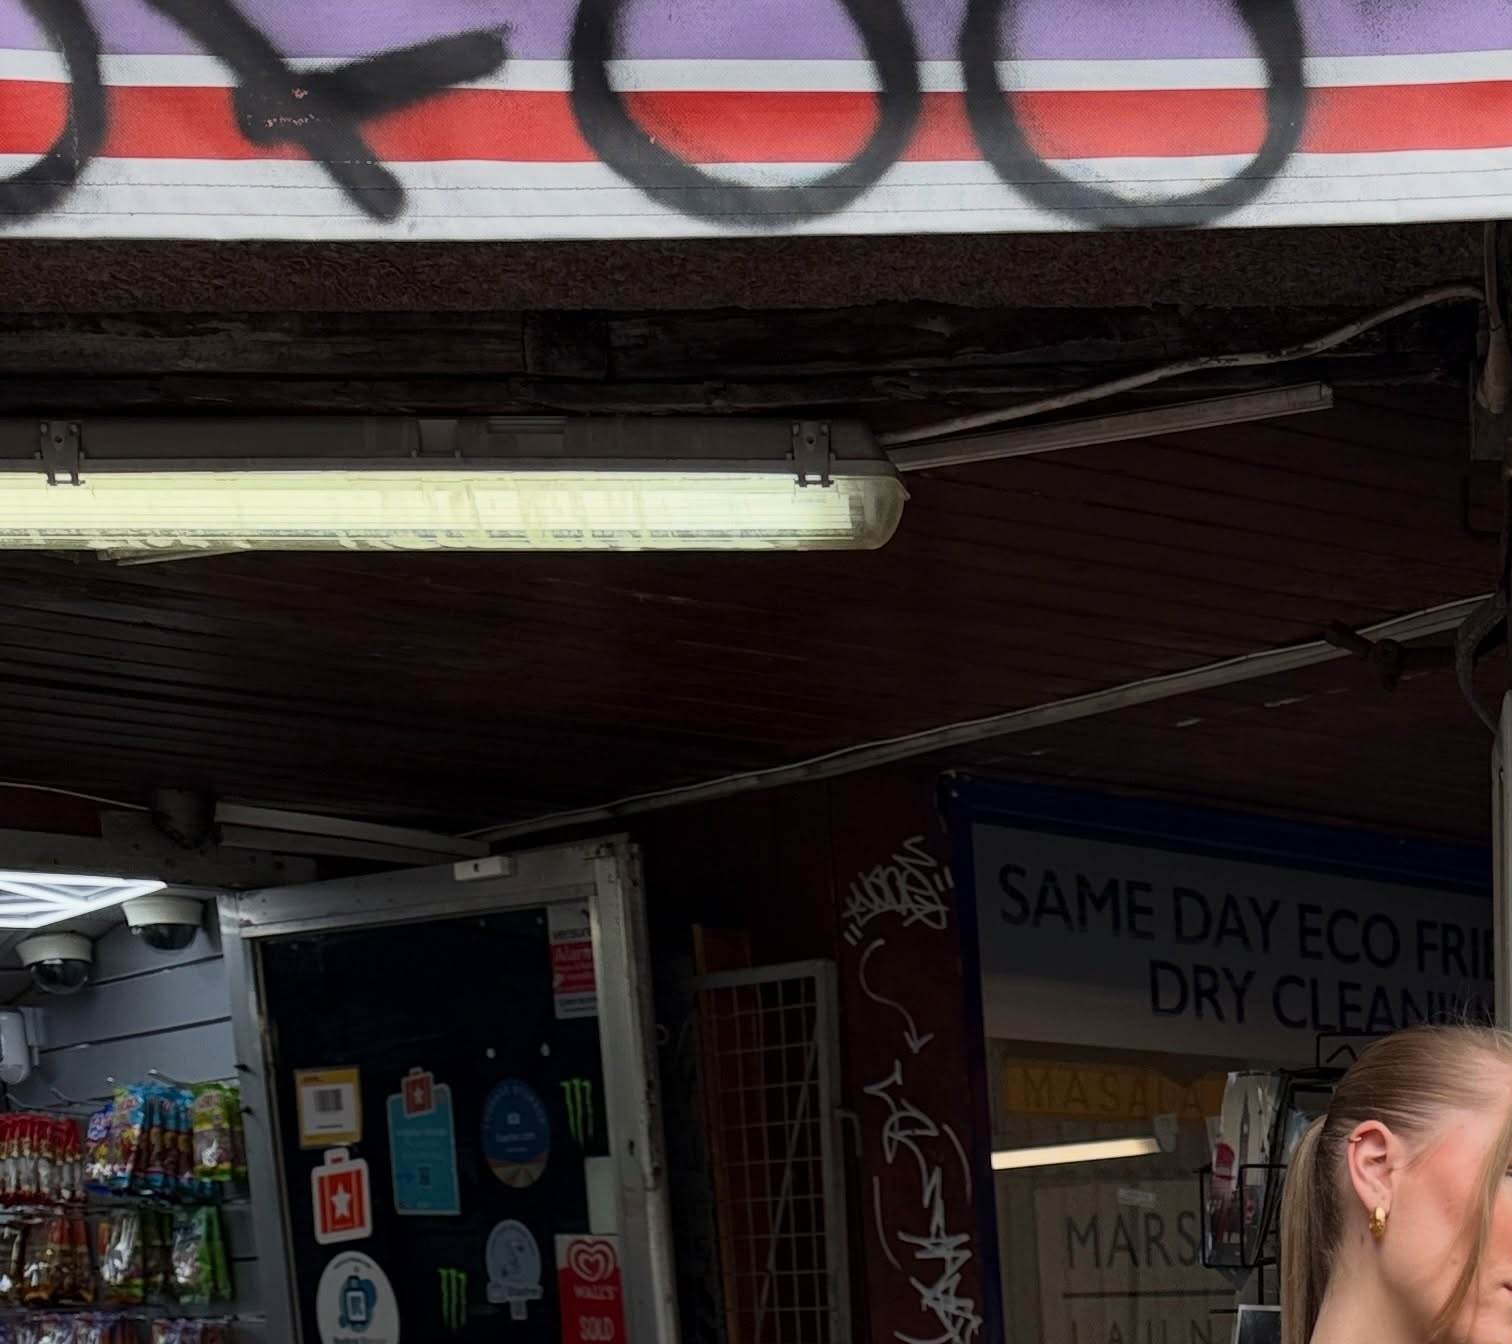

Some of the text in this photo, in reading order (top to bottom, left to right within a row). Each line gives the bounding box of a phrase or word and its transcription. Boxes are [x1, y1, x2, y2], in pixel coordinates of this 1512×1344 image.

[998, 861, 1156, 941] SAME
[1172, 885, 1280, 955] DAY
[1298, 904, 1401, 969] ECO
[1149, 958, 1257, 1026] DRY
[1064, 1210, 1200, 1271] MARS
